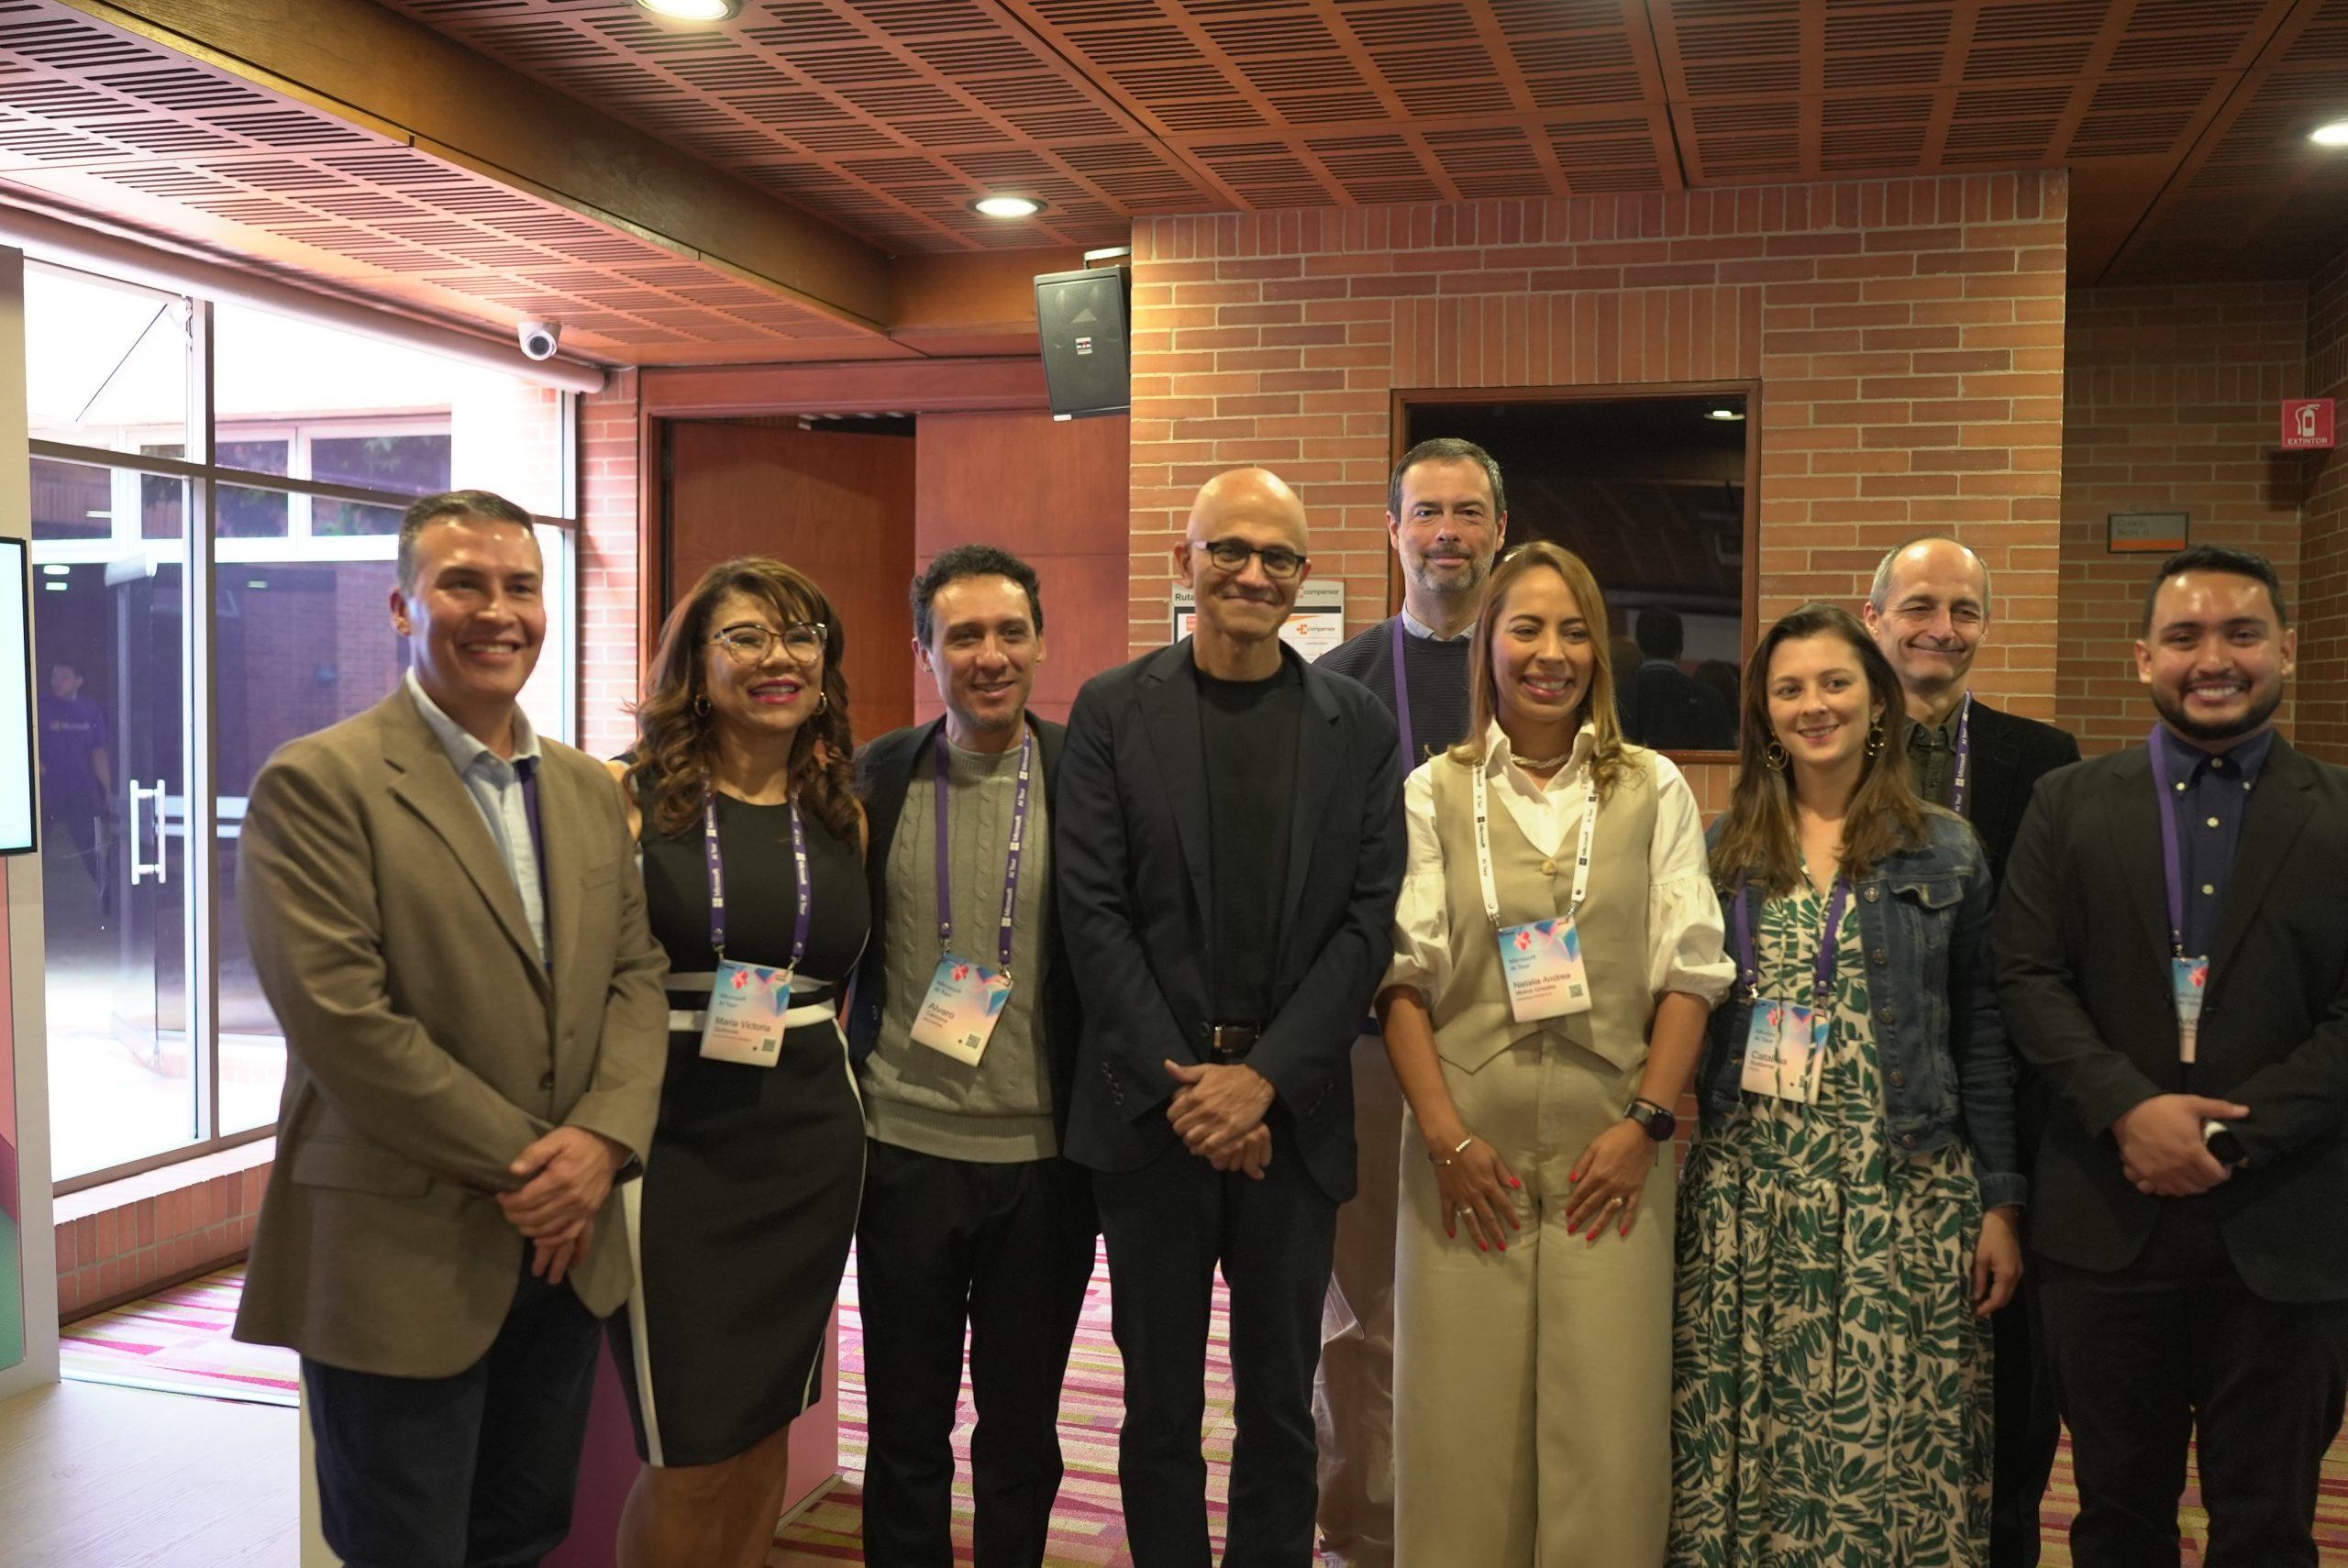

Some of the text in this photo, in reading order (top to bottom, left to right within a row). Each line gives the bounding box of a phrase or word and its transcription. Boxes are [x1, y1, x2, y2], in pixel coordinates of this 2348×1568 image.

[2287, 437, 2328, 446] EXTINTOR
[1302, 588, 1340, 597] compensar
[1021, 746, 1029, 771] Microsoft
[1956, 753, 1966, 778] Microsoft
[1012, 814, 1022, 842] Microsoft
[712, 868, 721, 896] Microsoft
[798, 861, 807, 886] Microsoft
[1003, 888, 1013, 916] Microsoft
[1513, 974, 1570, 988] Natalia Andrea
[928, 1002, 955, 1019] Alvaro
[741, 1021, 770, 1032] Victoria
